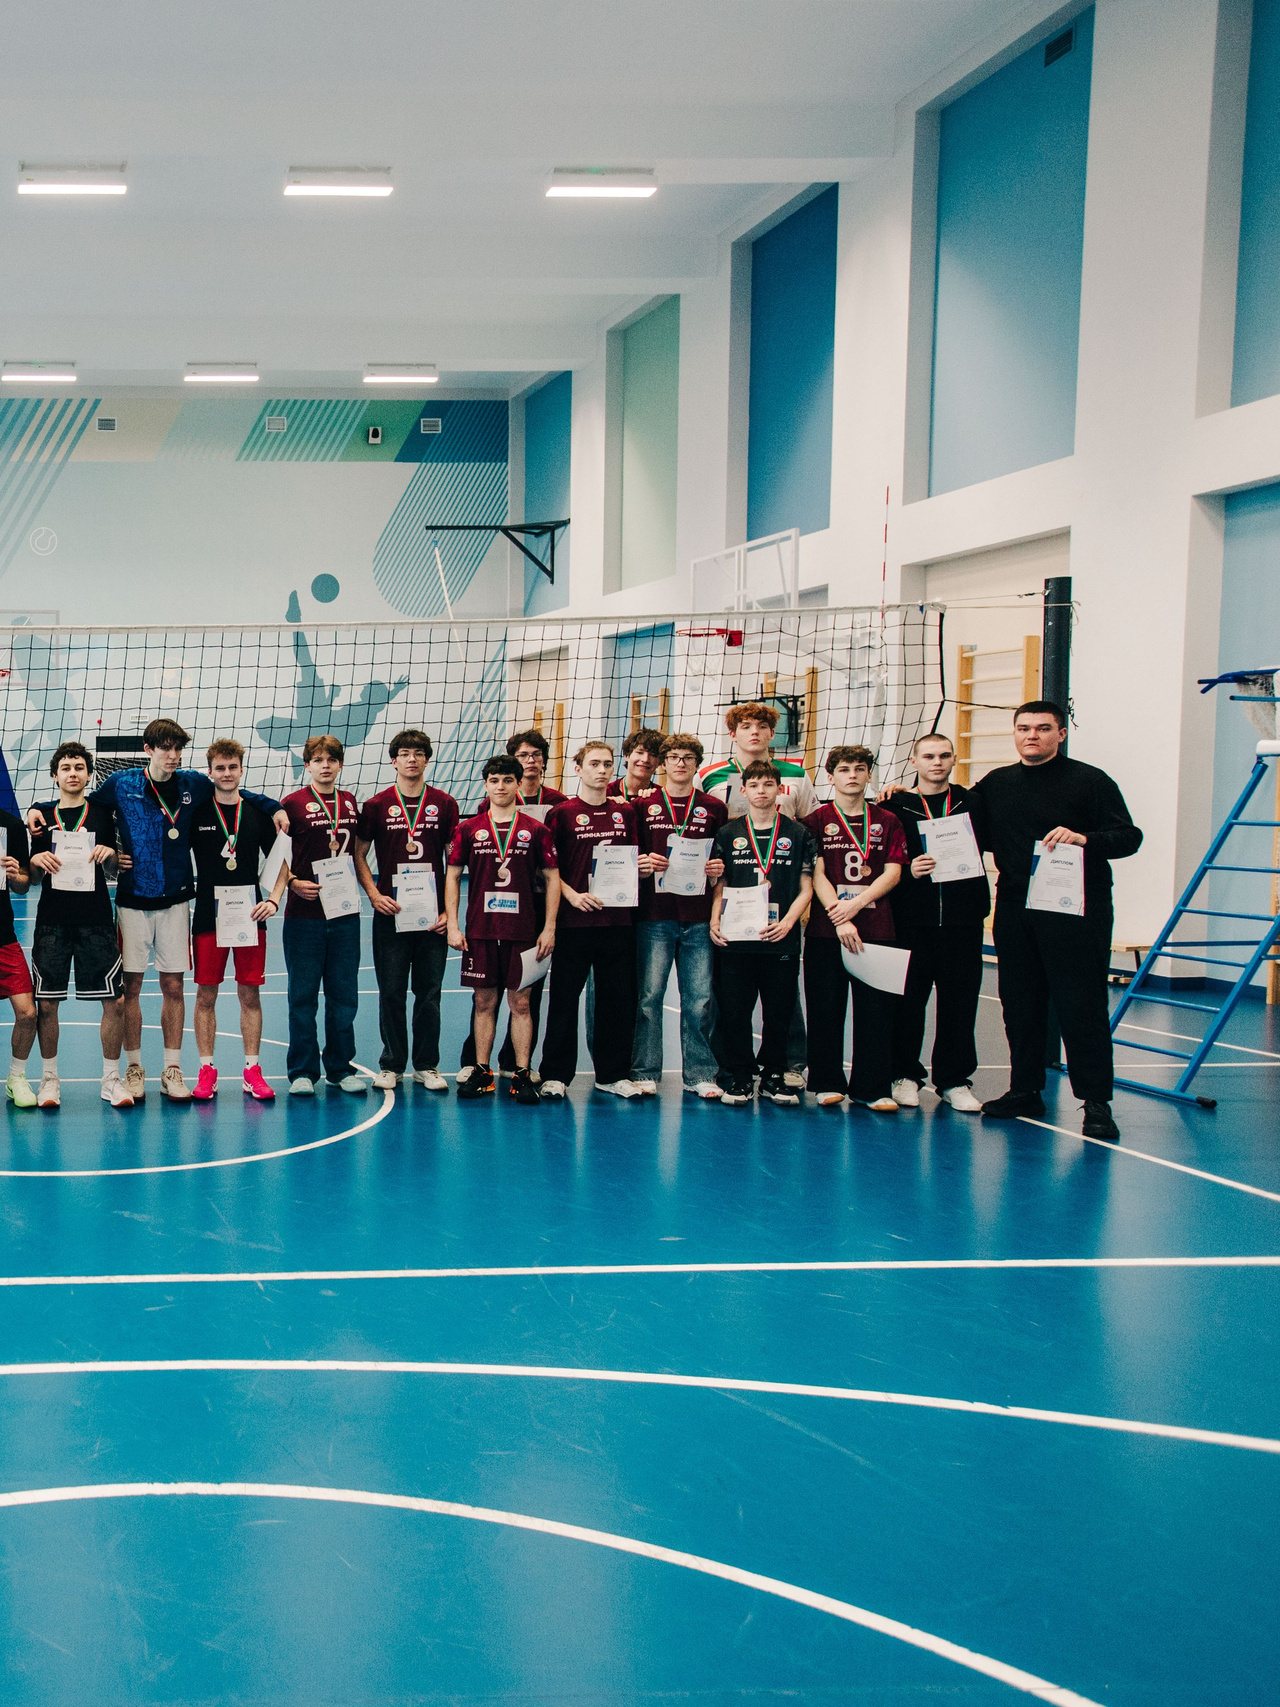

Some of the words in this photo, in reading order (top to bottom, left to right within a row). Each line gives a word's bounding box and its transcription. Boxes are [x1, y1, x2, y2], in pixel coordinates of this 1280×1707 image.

[326, 828, 351, 858] 12
[408, 831, 424, 860] 5
[935, 831, 959, 839] ДИПЛОМ
[494, 857, 511, 888] 3
[844, 851, 863, 882] 8
[468, 957, 474, 970] 3
